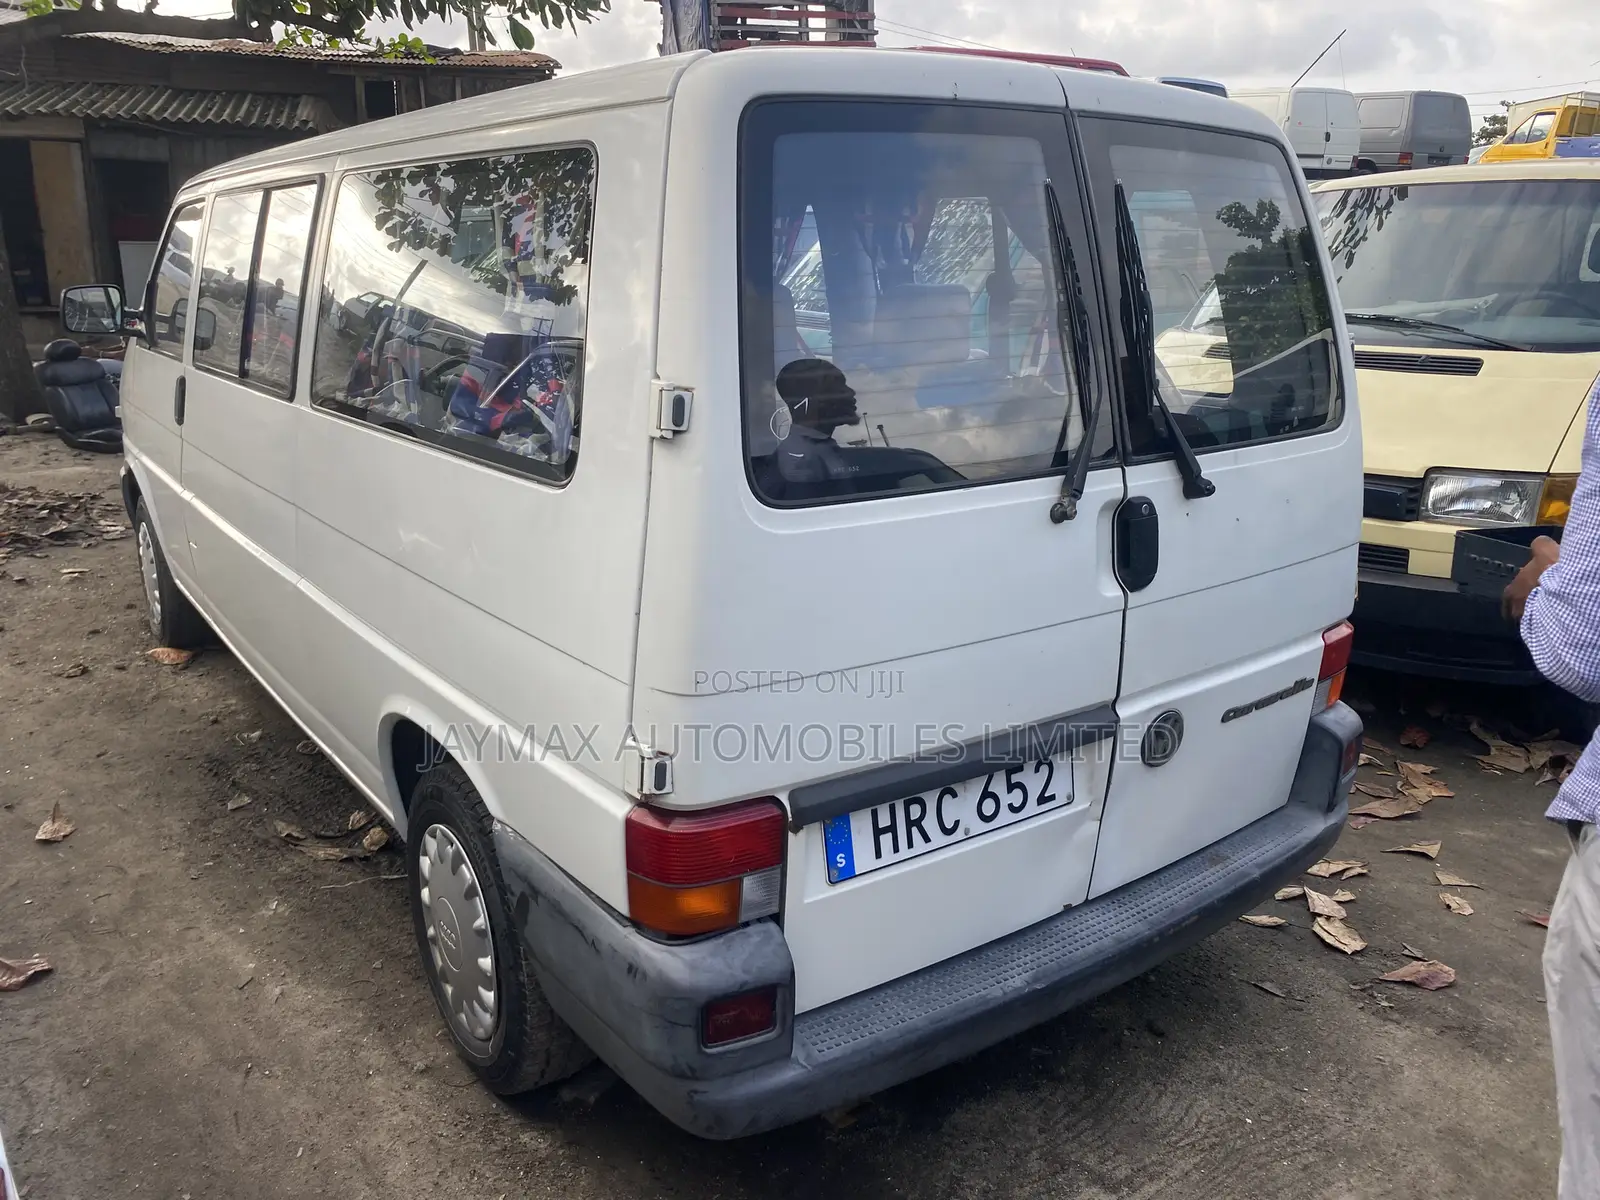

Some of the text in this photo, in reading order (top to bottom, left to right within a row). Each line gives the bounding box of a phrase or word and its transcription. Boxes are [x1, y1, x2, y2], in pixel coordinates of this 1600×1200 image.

[870, 758, 1057, 860] HRC 652
[836, 853, 847, 868] S
